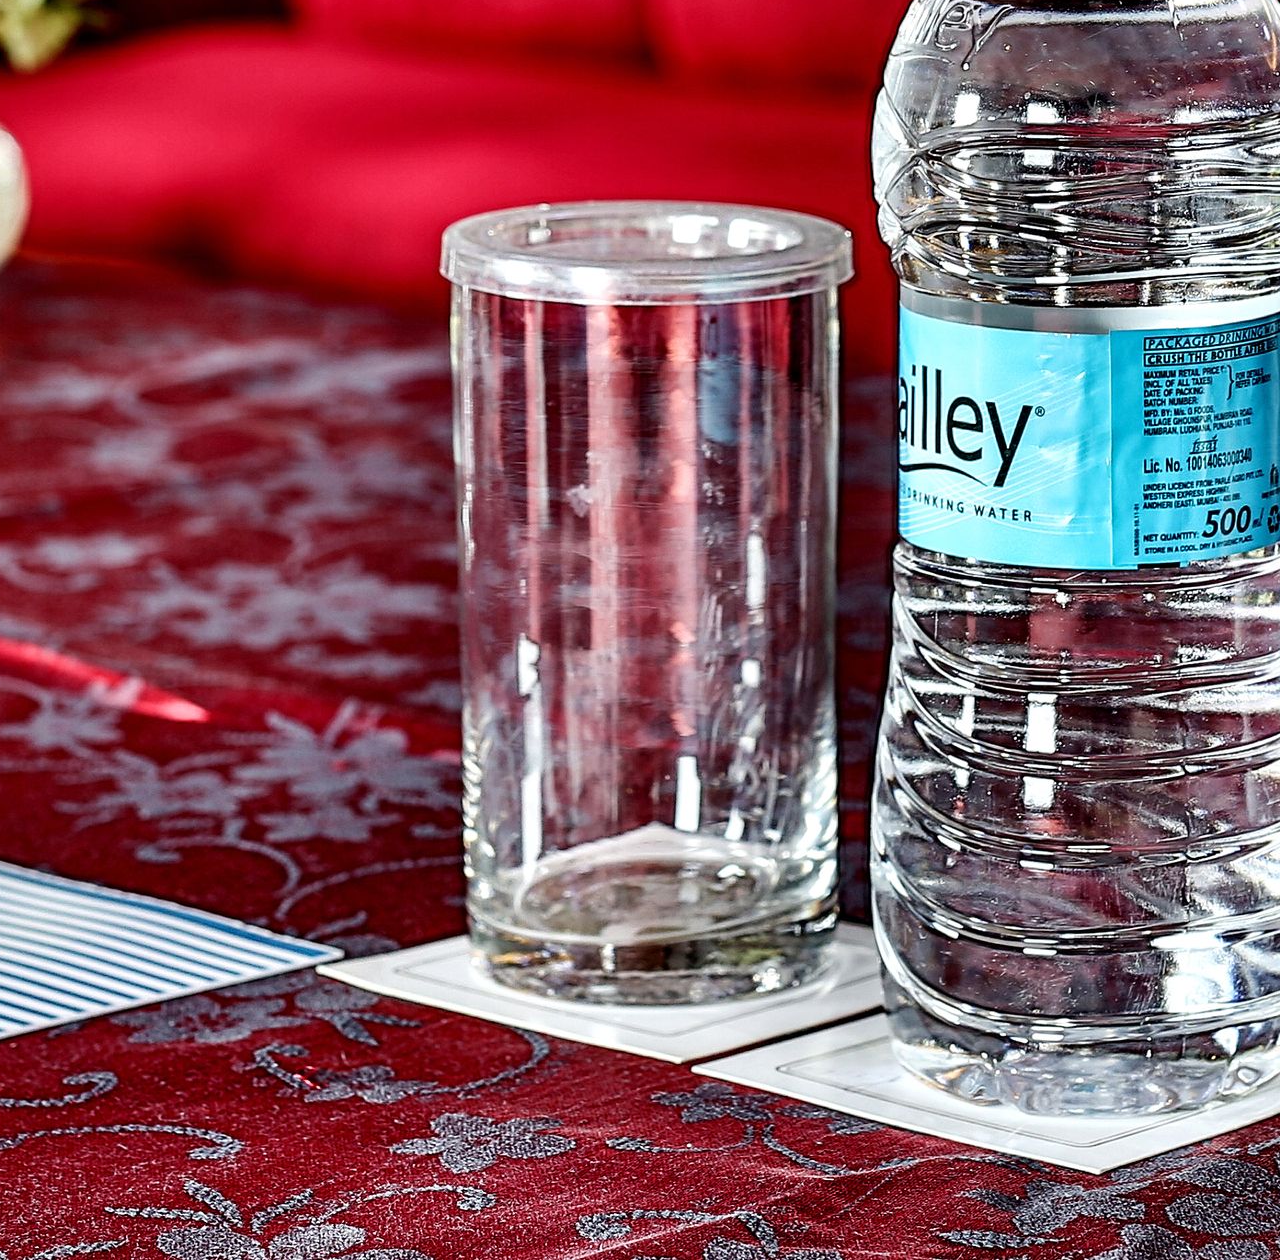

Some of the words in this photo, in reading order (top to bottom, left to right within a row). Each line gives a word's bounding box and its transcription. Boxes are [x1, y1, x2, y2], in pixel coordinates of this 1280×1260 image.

[1148, 335, 1216, 350] PACKAGED
[1218, 325, 1265, 344] DRINKING
[1148, 352, 1184, 365] CRUSH
[1189, 351, 1208, 362] THE
[1211, 346, 1243, 359] BOTTLE
[1245, 341, 1265, 355] AFTER
[1143, 370, 1176, 379] MAXIMUM
[1179, 368, 1200, 378] RETAIL
[1202, 366, 1220, 376] PRICE
[1166, 378, 1175, 387] OF
[1177, 377, 1190, 386] ALL
[1192, 375, 1213, 386] TAXES)
[1143, 388, 1162, 398] DATE
[1163, 387, 1174, 397] OF
[1143, 398, 1166, 408] BATCH
[1143, 418, 1172, 427] VILLAGE
[1143, 459, 1163, 474] Lic.
[1166, 457, 1183, 473] No.
[1143, 483, 1167, 492] UNDER
[1167, 481, 1195, 490] LICENCE
[1143, 491, 1176, 500] WESTERN
[1177, 489, 1204, 499] EXPRESS
[907, 487, 965, 514] DRINKING
[973, 504, 1032, 522] WATER
[1143, 501, 1173, 509] ANDHERI
[1143, 534, 1159, 542] NET
[1160, 531, 1200, 542] QUANTITY:
[1201, 505, 1252, 539] 500
[1144, 546, 1166, 555] STORE
[1166, 545, 1174, 554] IN
[1174, 545, 1180, 553] A
[1199, 541, 1210, 551] DRY
